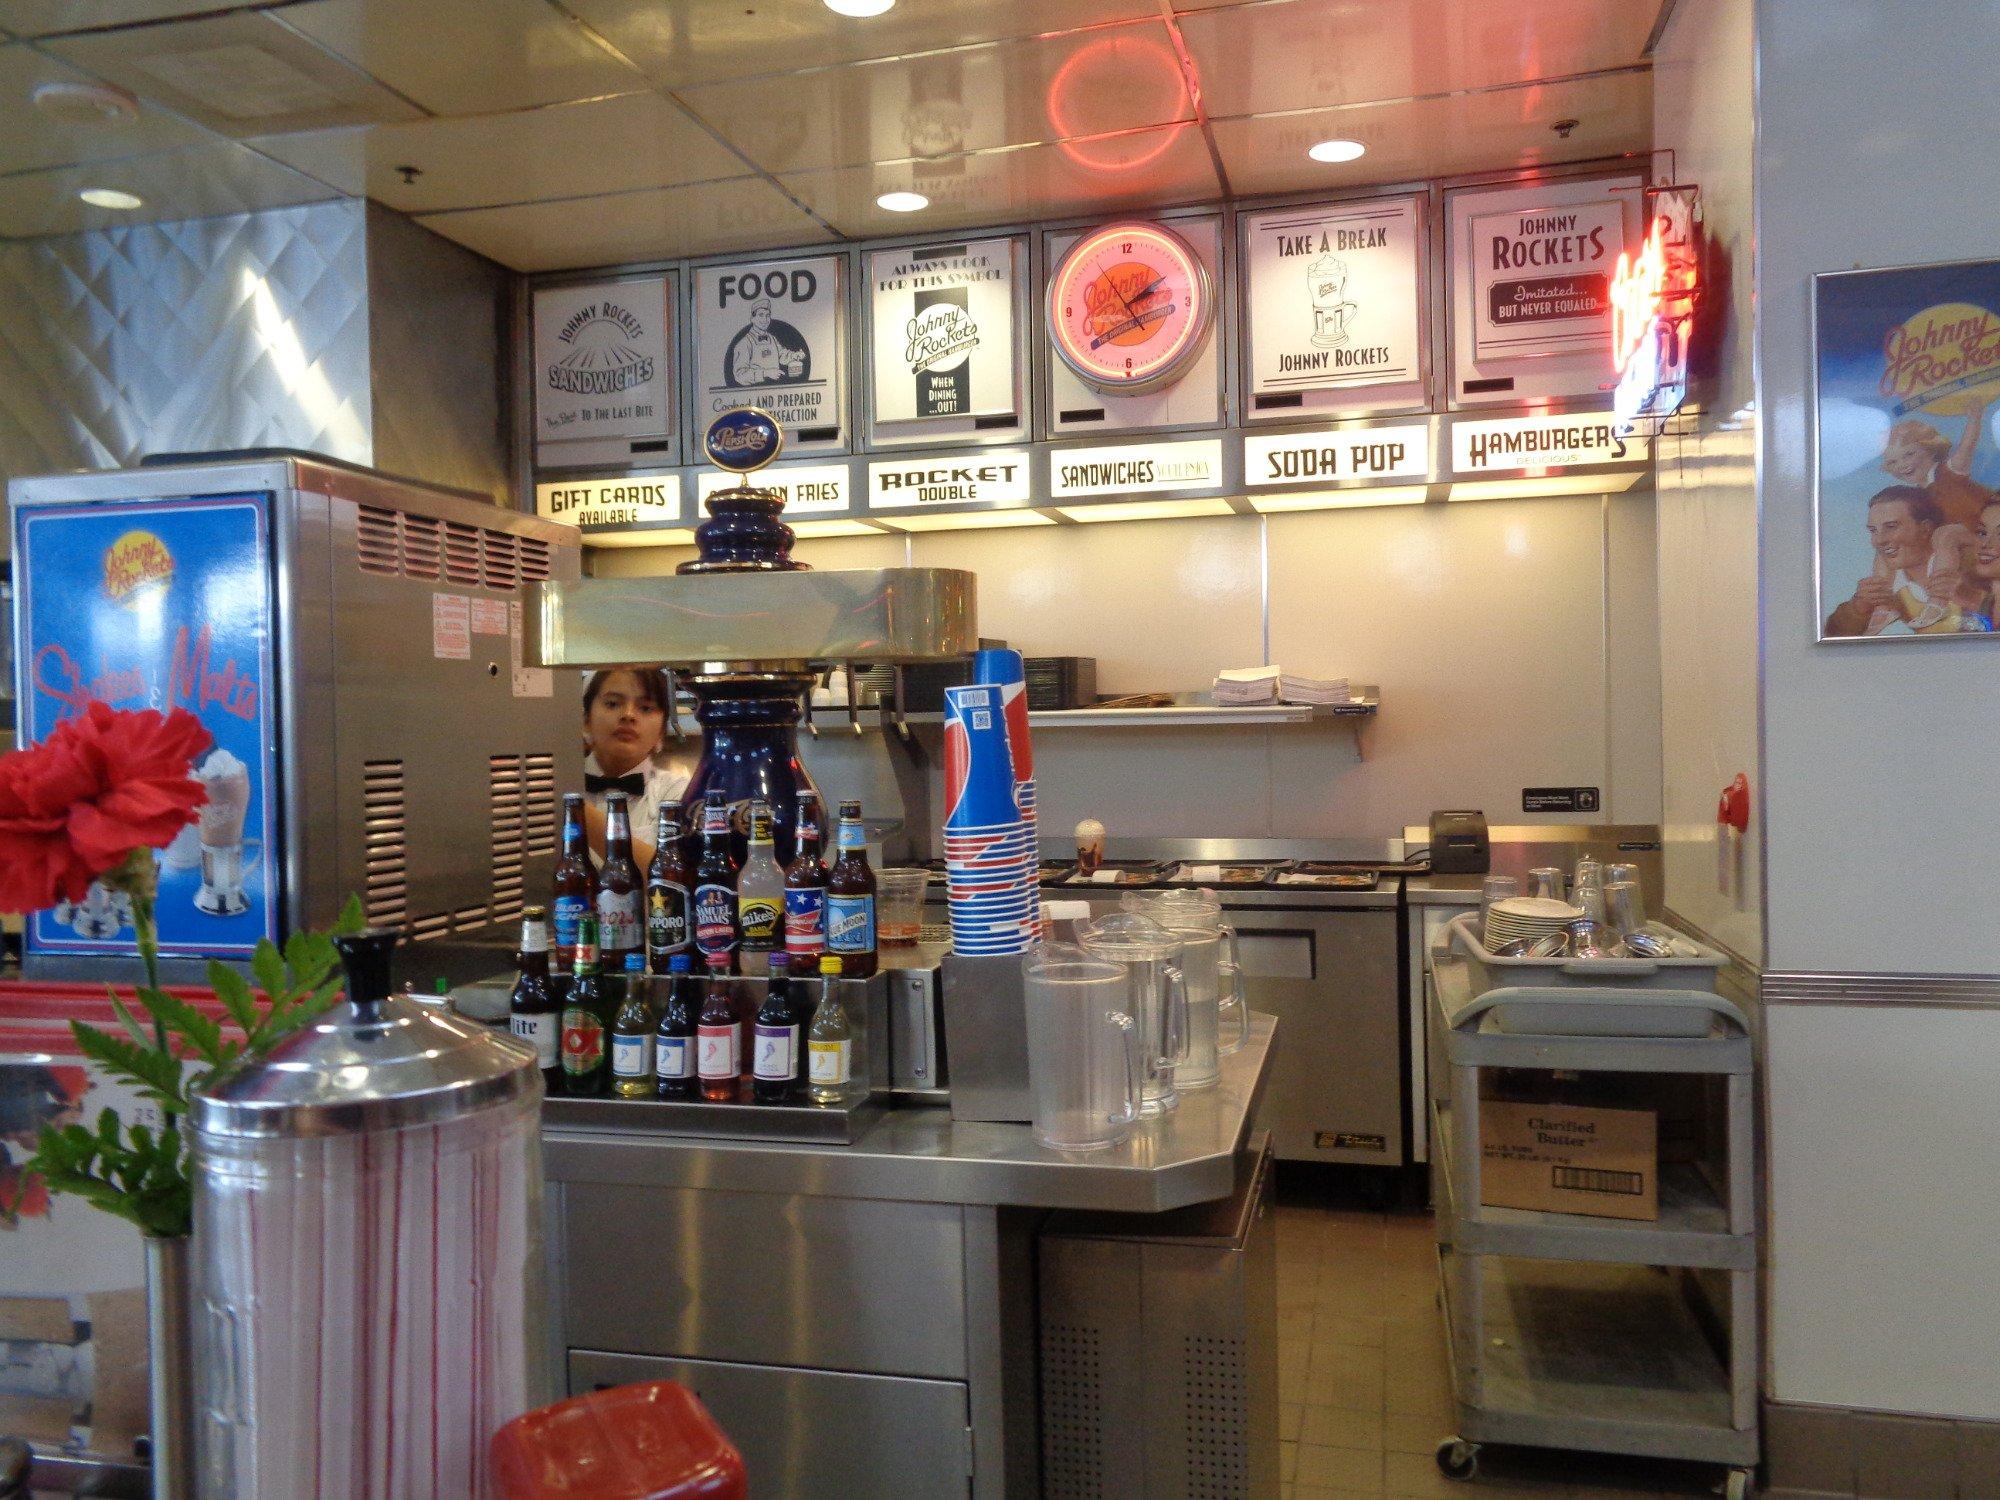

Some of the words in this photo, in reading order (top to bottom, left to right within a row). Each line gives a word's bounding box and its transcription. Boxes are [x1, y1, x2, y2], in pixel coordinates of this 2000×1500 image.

[1519, 215, 1577, 236] JOHNNY
[1121, 243, 1132, 253] 12
[1277, 235, 1312, 257] TAKE
[1320, 231, 1330, 252] A
[1338, 228, 1387, 250] BREAK
[1492, 226, 1605, 270] ROCKETS
[891, 260, 948, 276] ALWAYS
[719, 270, 817, 309] FOOD
[880, 280, 908, 291] FOR
[913, 275, 943, 288] THIS
[1185, 296, 1191, 306] 3
[1499, 305, 1518, 317] BUT
[1521, 302, 1551, 316] NEVER
[1555, 298, 1597, 314] EQUALED
[1066, 307, 1072, 317] 9
[559, 304, 596, 343] JOHNNY
[603, 302, 644, 339] ROCKETS
[905, 306, 967, 363] Johnny
[914, 321, 978, 363] Rockets
[1125, 358, 1132, 368] 6
[1279, 352, 1329, 372] JOHNNY
[1335, 347, 1389, 367] ROCKETS
[1880, 312, 2000, 397] Johnny
[549, 356, 654, 395] SANDWICHES
[931, 377, 954, 388] WHEN
[756, 395, 774, 408] AND
[777, 392, 822, 406] PREPARED
[928, 389, 957, 401] DINING
[595, 408, 609, 420] THE
[612, 406, 632, 419] LAST
[635, 405, 653, 417] BITE
[1470, 425, 1627, 467] HAMBURGERS
[1268, 448, 1336, 478] SODA
[1350, 443, 1404, 473] POP
[1516, 454, 1578, 465] DELICIOUS
[879, 465, 1018, 490] ROCKET
[1062, 460, 1154, 488] SANDWICHES
[551, 489, 591, 513] GIFT
[600, 485, 665, 506] CARDS
[797, 483, 839, 502] FRIES
[919, 485, 977, 501] DOUBLE
[579, 509, 638, 524] AVAILABLE
[695, 904, 733, 918] SAMUEL
[649, 916, 685, 929] PPORO
[1527, 1117, 1596, 1134] Clarified
[1536, 1132, 1587, 1147] Butter
